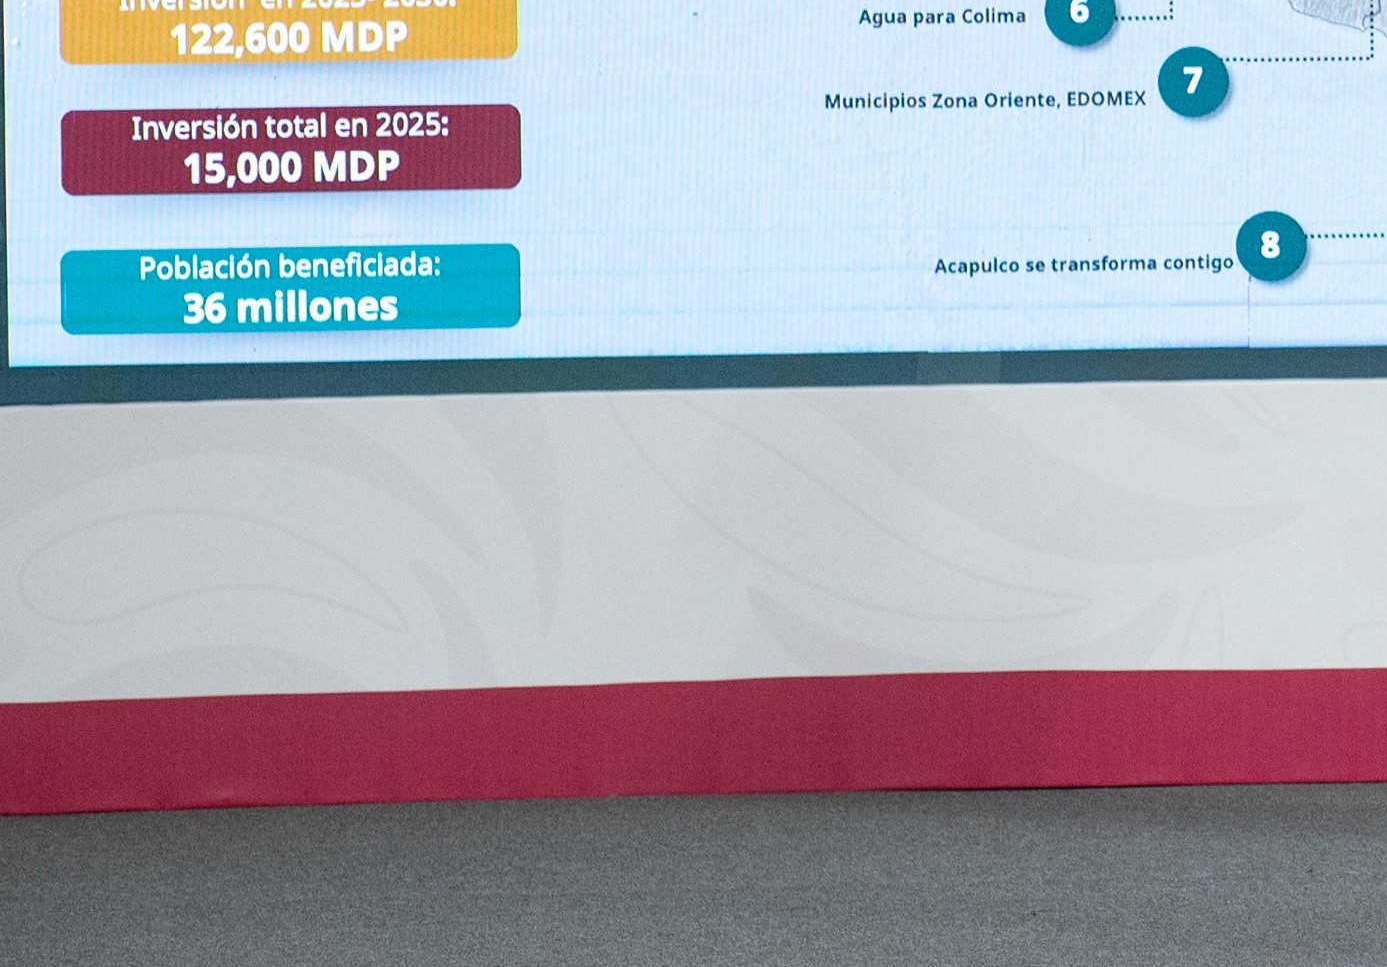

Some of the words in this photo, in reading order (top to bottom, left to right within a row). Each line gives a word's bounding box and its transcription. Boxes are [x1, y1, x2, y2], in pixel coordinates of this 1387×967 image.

[859, 7, 908, 28] Agua
[913, 10, 956, 28] para
[962, 7, 1026, 25] Colima
[170, 23, 310, 59] 122,600
[320, 20, 408, 52] MDP
[1183, 67, 1203, 93] 7
[825, 91, 927, 112] Municipios
[932, 91, 979, 110] Zona
[984, 90, 1062, 112] Oriente,
[1067, 90, 1147, 109] EDOMEX
[132, 114, 257, 141] Inversión
[265, 113, 326, 139] total
[334, 117, 368, 138] en
[376, 111, 450, 138] 2025:
[184, 152, 302, 189] 15,000
[313, 149, 401, 182] MDP
[1260, 232, 1280, 258] 8
[139, 254, 270, 281] Población
[278, 251, 440, 280] beneficiada:
[934, 256, 1020, 278] Acapulco
[1027, 258, 1046, 274] se
[1051, 254, 1157, 274] transforma
[1163, 253, 1235, 275] contigo
[183, 294, 226, 324] 36
[236, 289, 398, 322] millones
